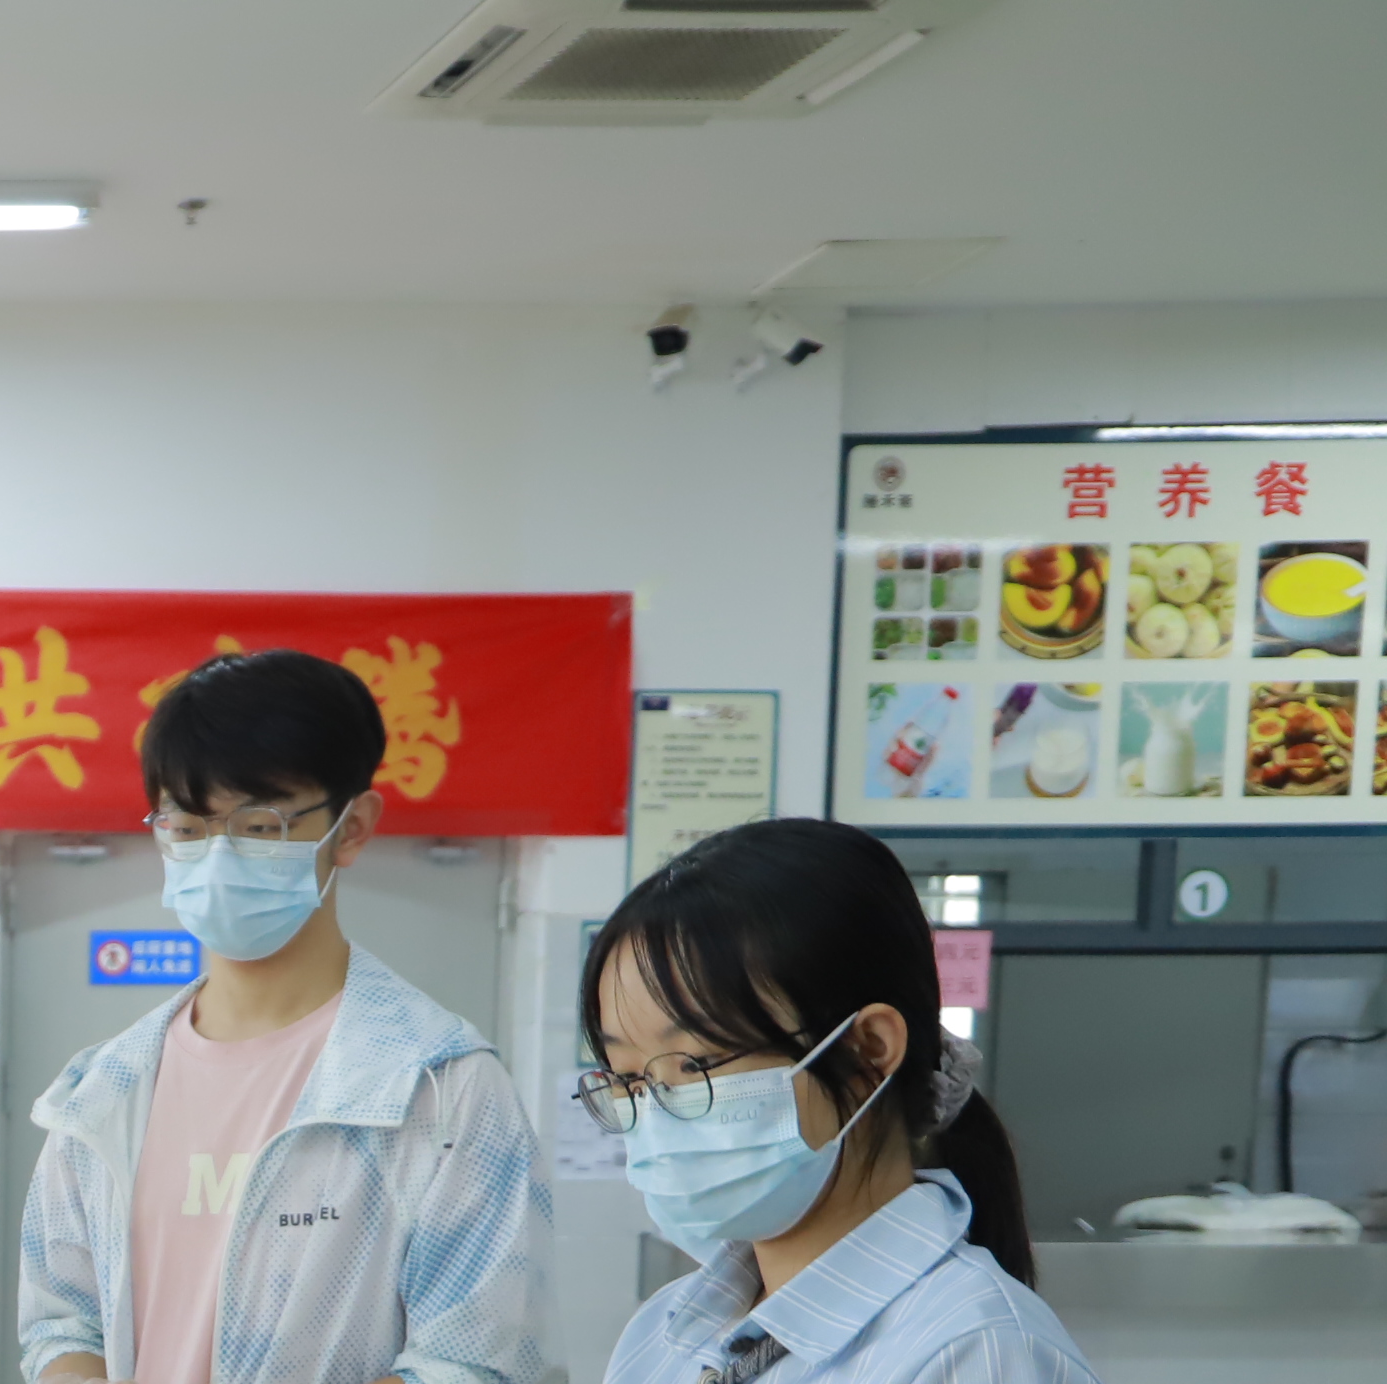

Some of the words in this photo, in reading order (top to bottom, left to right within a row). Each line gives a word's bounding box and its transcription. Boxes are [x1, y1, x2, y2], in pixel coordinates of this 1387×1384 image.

[1062, 461, 1309, 518] 营养餐
[278, 1206, 341, 1228] BUREL
